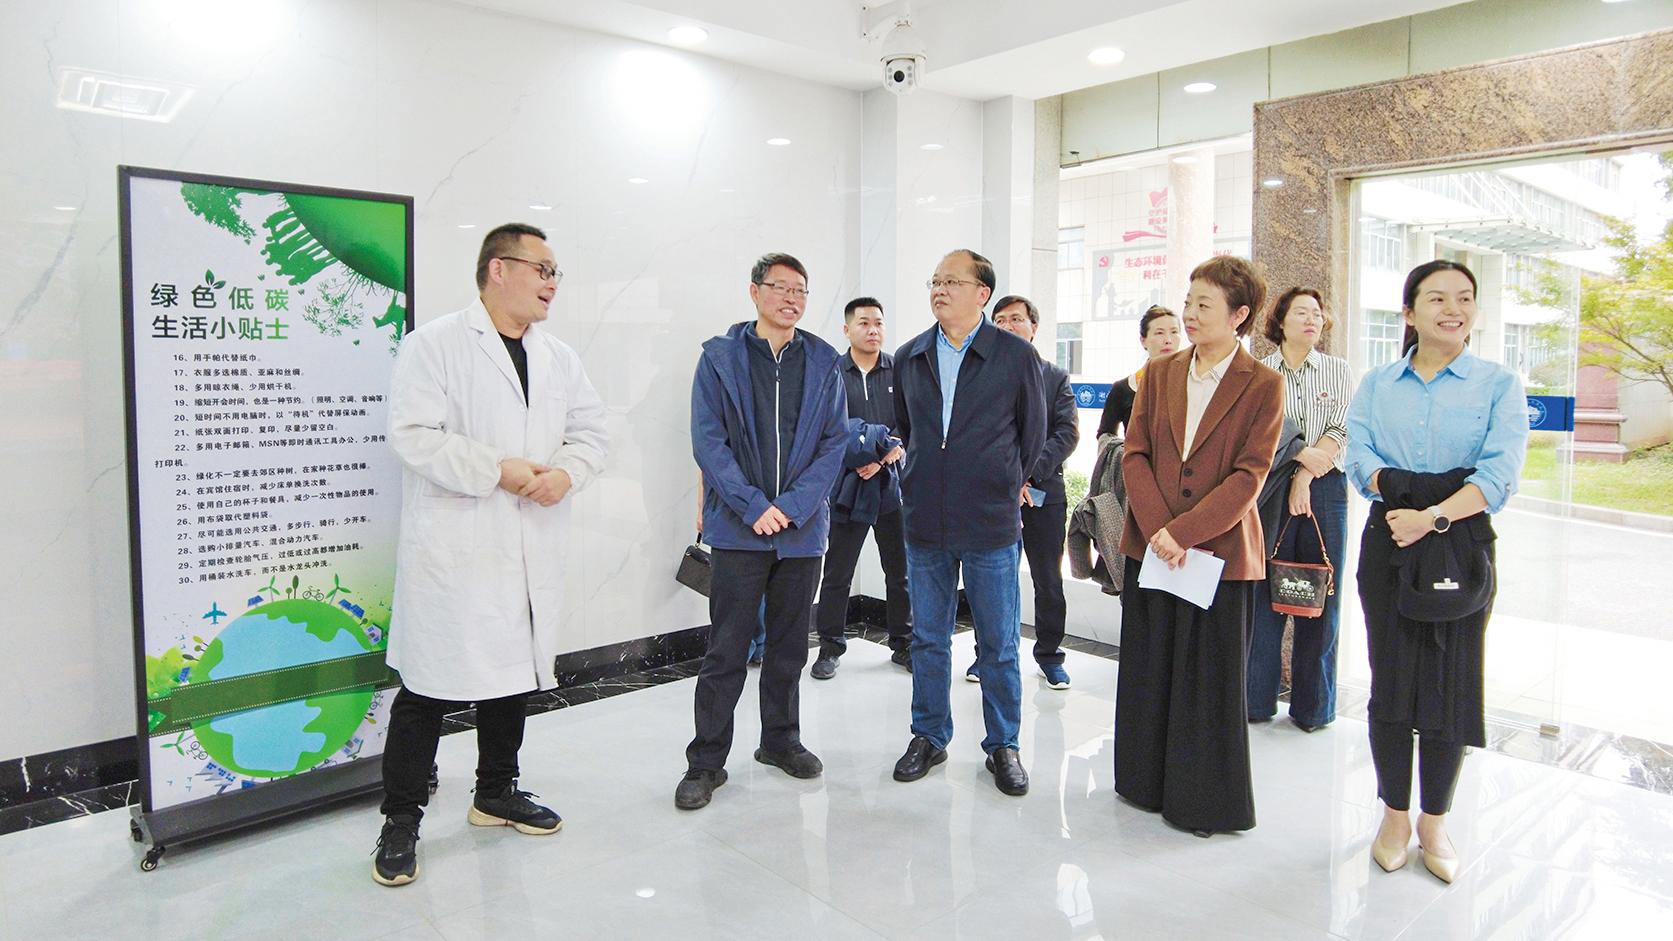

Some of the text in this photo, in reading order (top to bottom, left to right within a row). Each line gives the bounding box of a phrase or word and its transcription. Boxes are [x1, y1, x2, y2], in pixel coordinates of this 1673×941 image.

[150, 282, 290, 312] 绿色低碳
[151, 315, 290, 341] 生活小贴士
[155, 459, 189, 468] 打印机。
